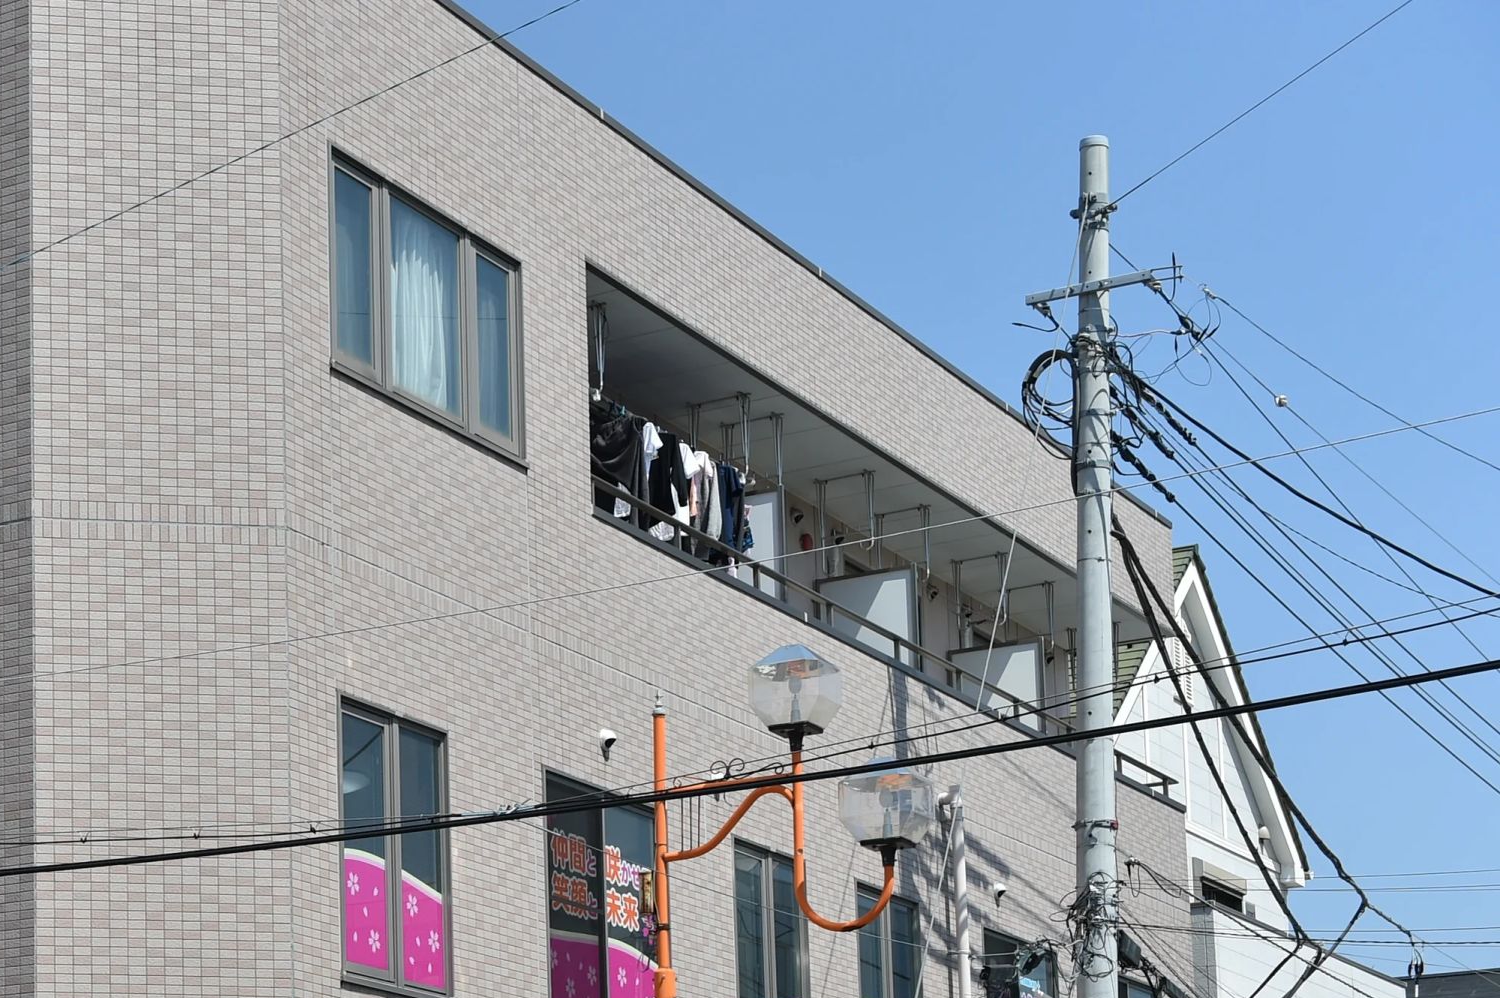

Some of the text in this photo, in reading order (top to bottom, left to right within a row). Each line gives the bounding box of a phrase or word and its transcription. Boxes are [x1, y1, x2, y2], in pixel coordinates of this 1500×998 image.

[551, 829, 645, 892] 仲間と咲かせ
